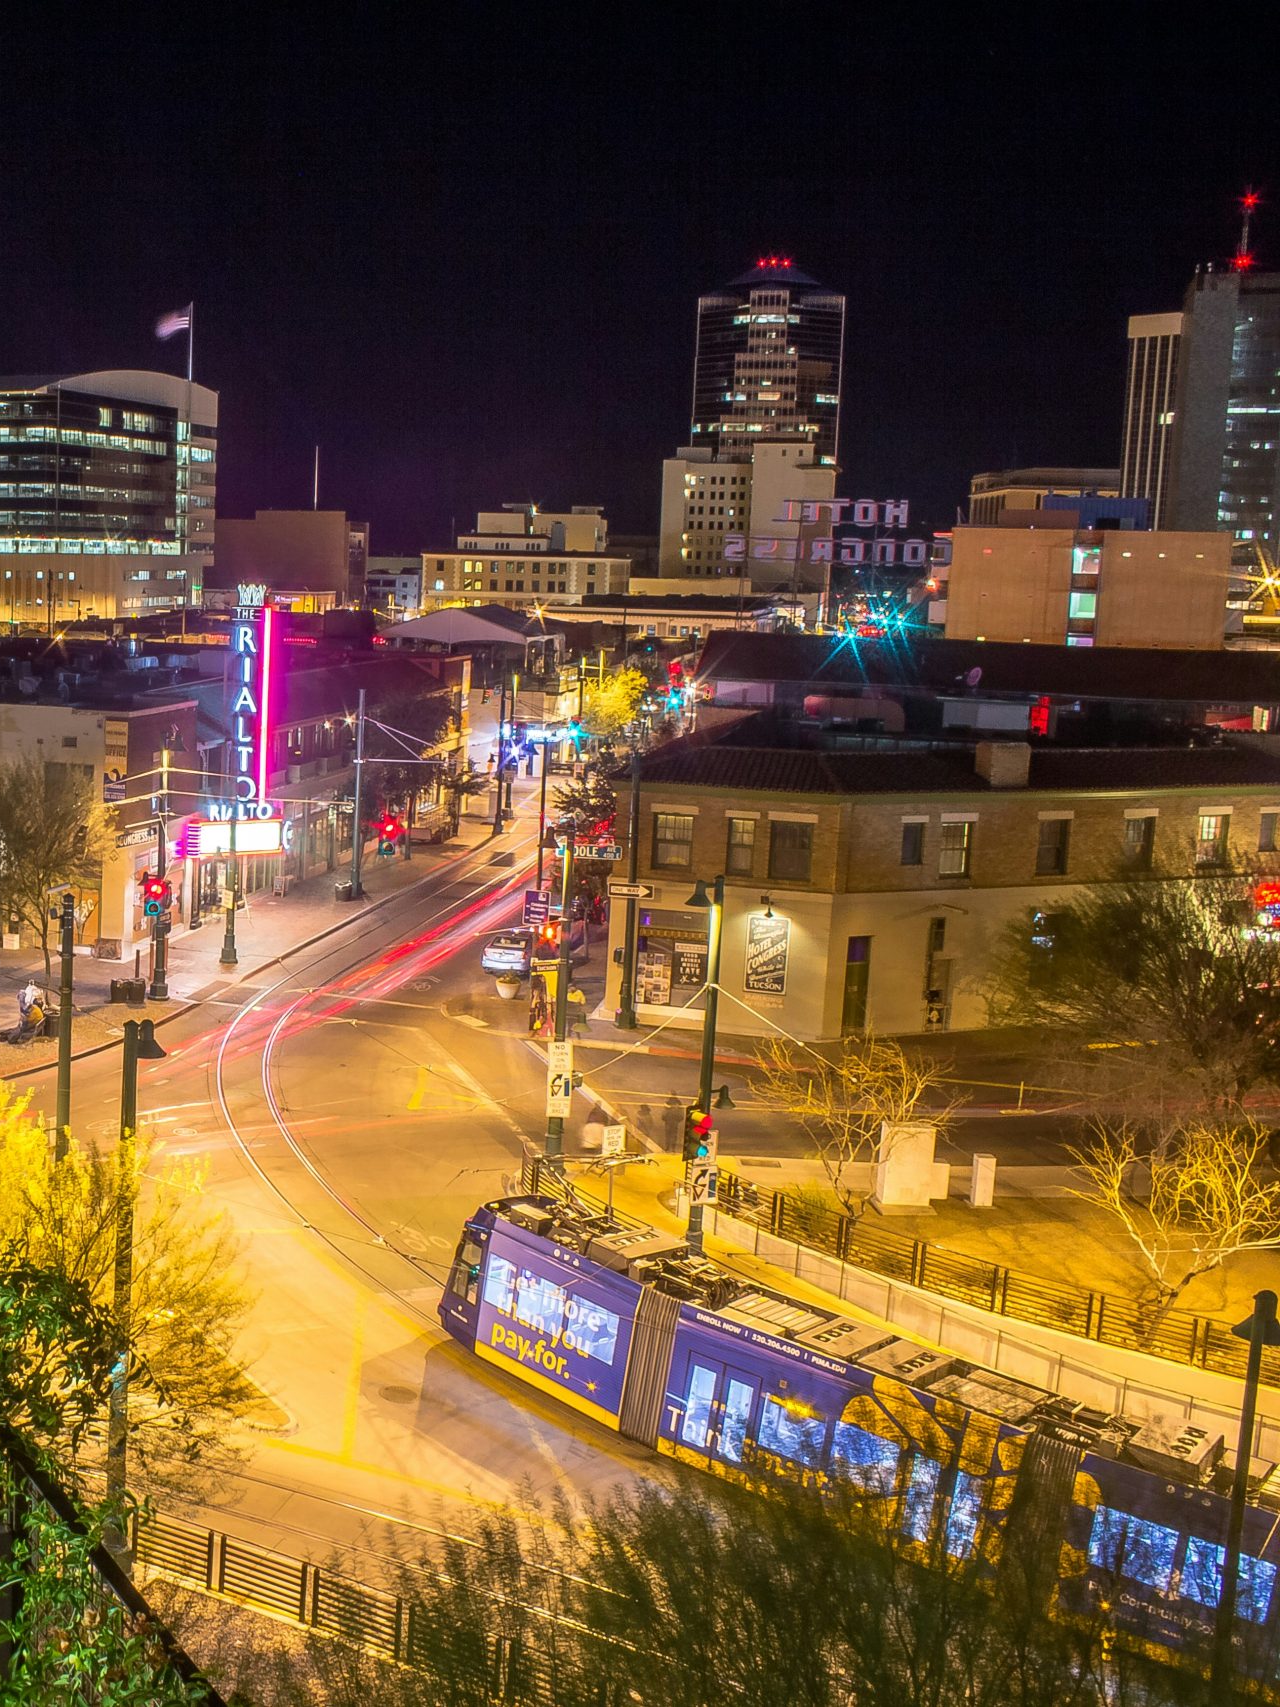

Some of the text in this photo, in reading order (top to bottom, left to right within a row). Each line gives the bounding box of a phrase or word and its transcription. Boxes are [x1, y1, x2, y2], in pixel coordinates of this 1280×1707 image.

[236, 608, 255, 620] THE
[235, 626, 257, 803] RIALTO
[118, 830, 149, 847] CONGRESS
[573, 846, 599, 857] OOLE
[747, 939, 787, 975] CONGRESS
[748, 938, 773, 959] HOTEL
[680, 967, 701, 975] LATE
[749, 981, 782, 991] TUCSON
[504, 1264, 602, 1333] Get more
[496, 1290, 592, 1359] than you
[490, 1322, 571, 1380] pay for.
[696, 1312, 847, 1375] ENROLL NOW 520.206.4500 PIMA.EDU
[667, 1405, 742, 1463] Think
